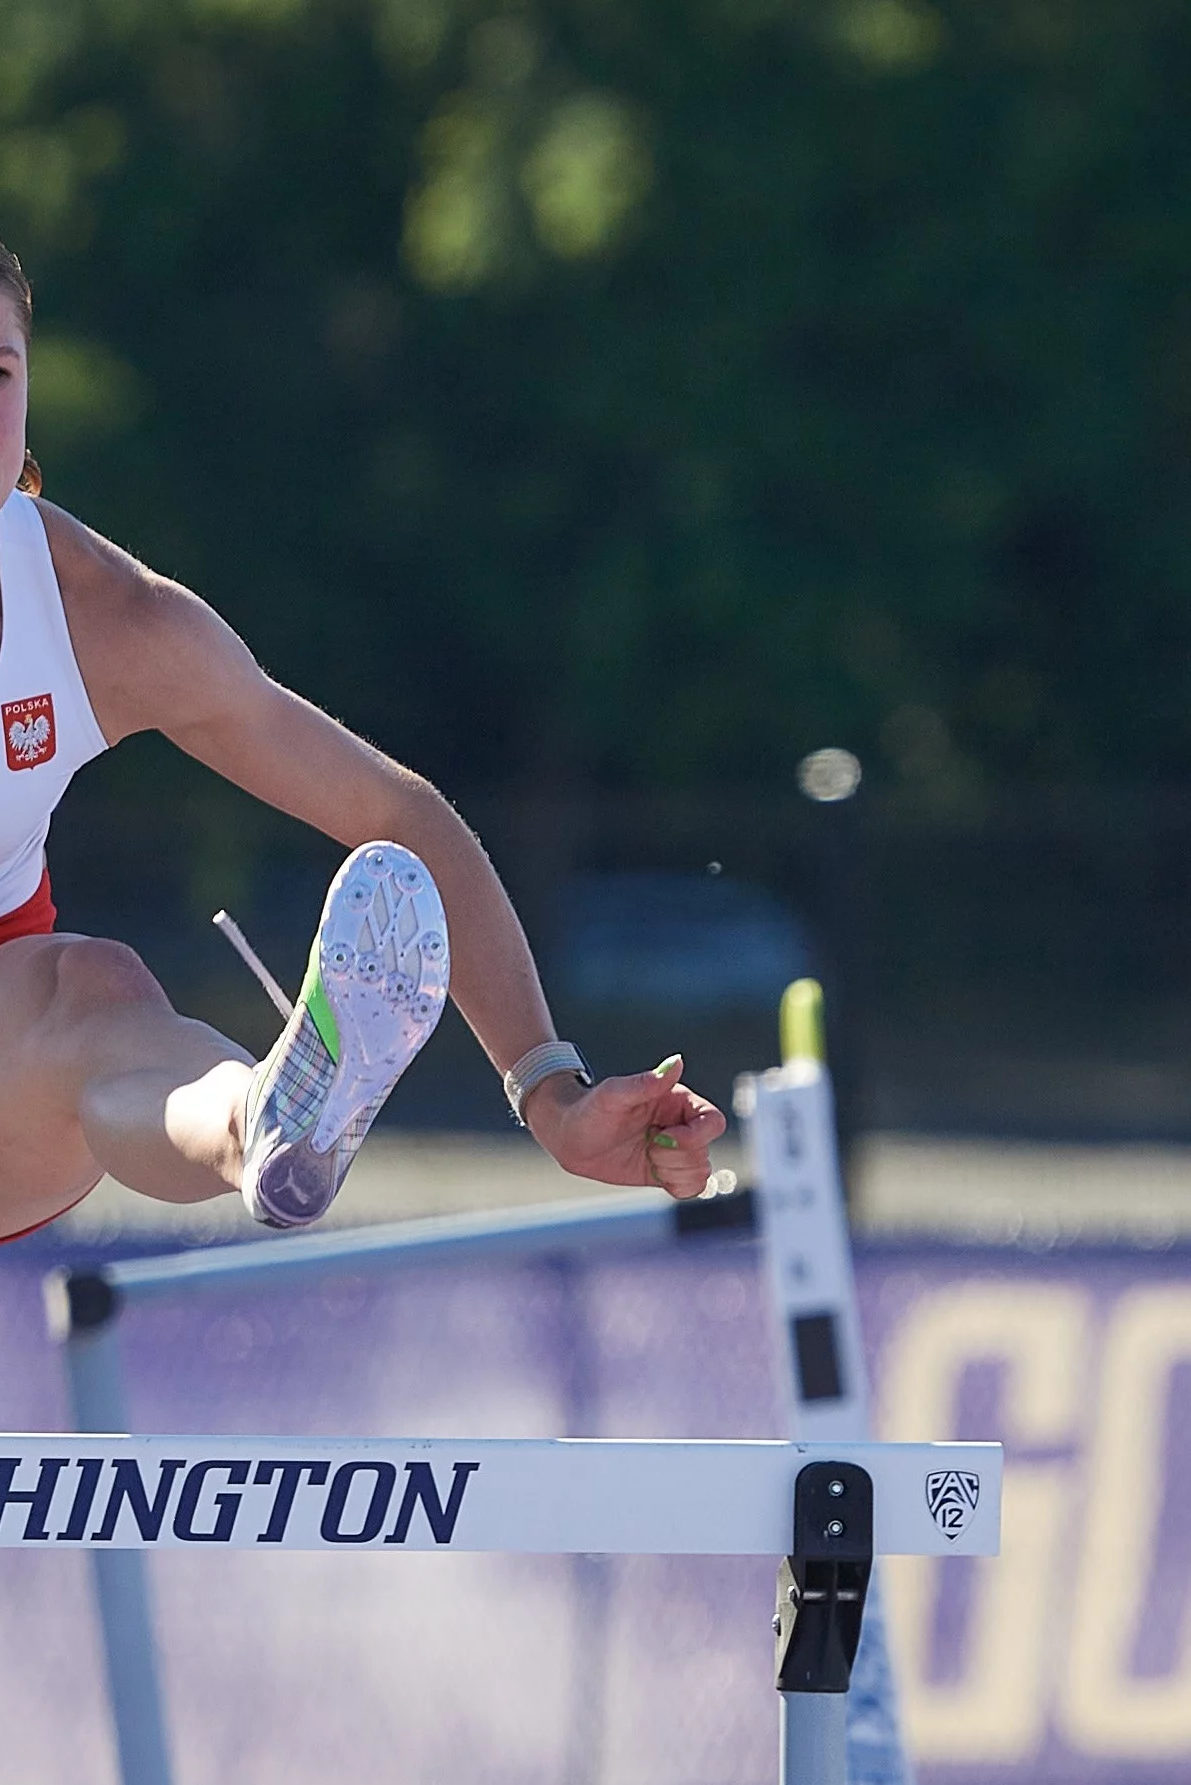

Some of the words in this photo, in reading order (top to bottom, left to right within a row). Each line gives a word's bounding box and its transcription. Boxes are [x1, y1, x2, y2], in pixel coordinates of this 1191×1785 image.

[4, 697, 50, 716] POLSKA
[927, 1472, 980, 1509] PAC
[942, 1509, 963, 1528] 12
